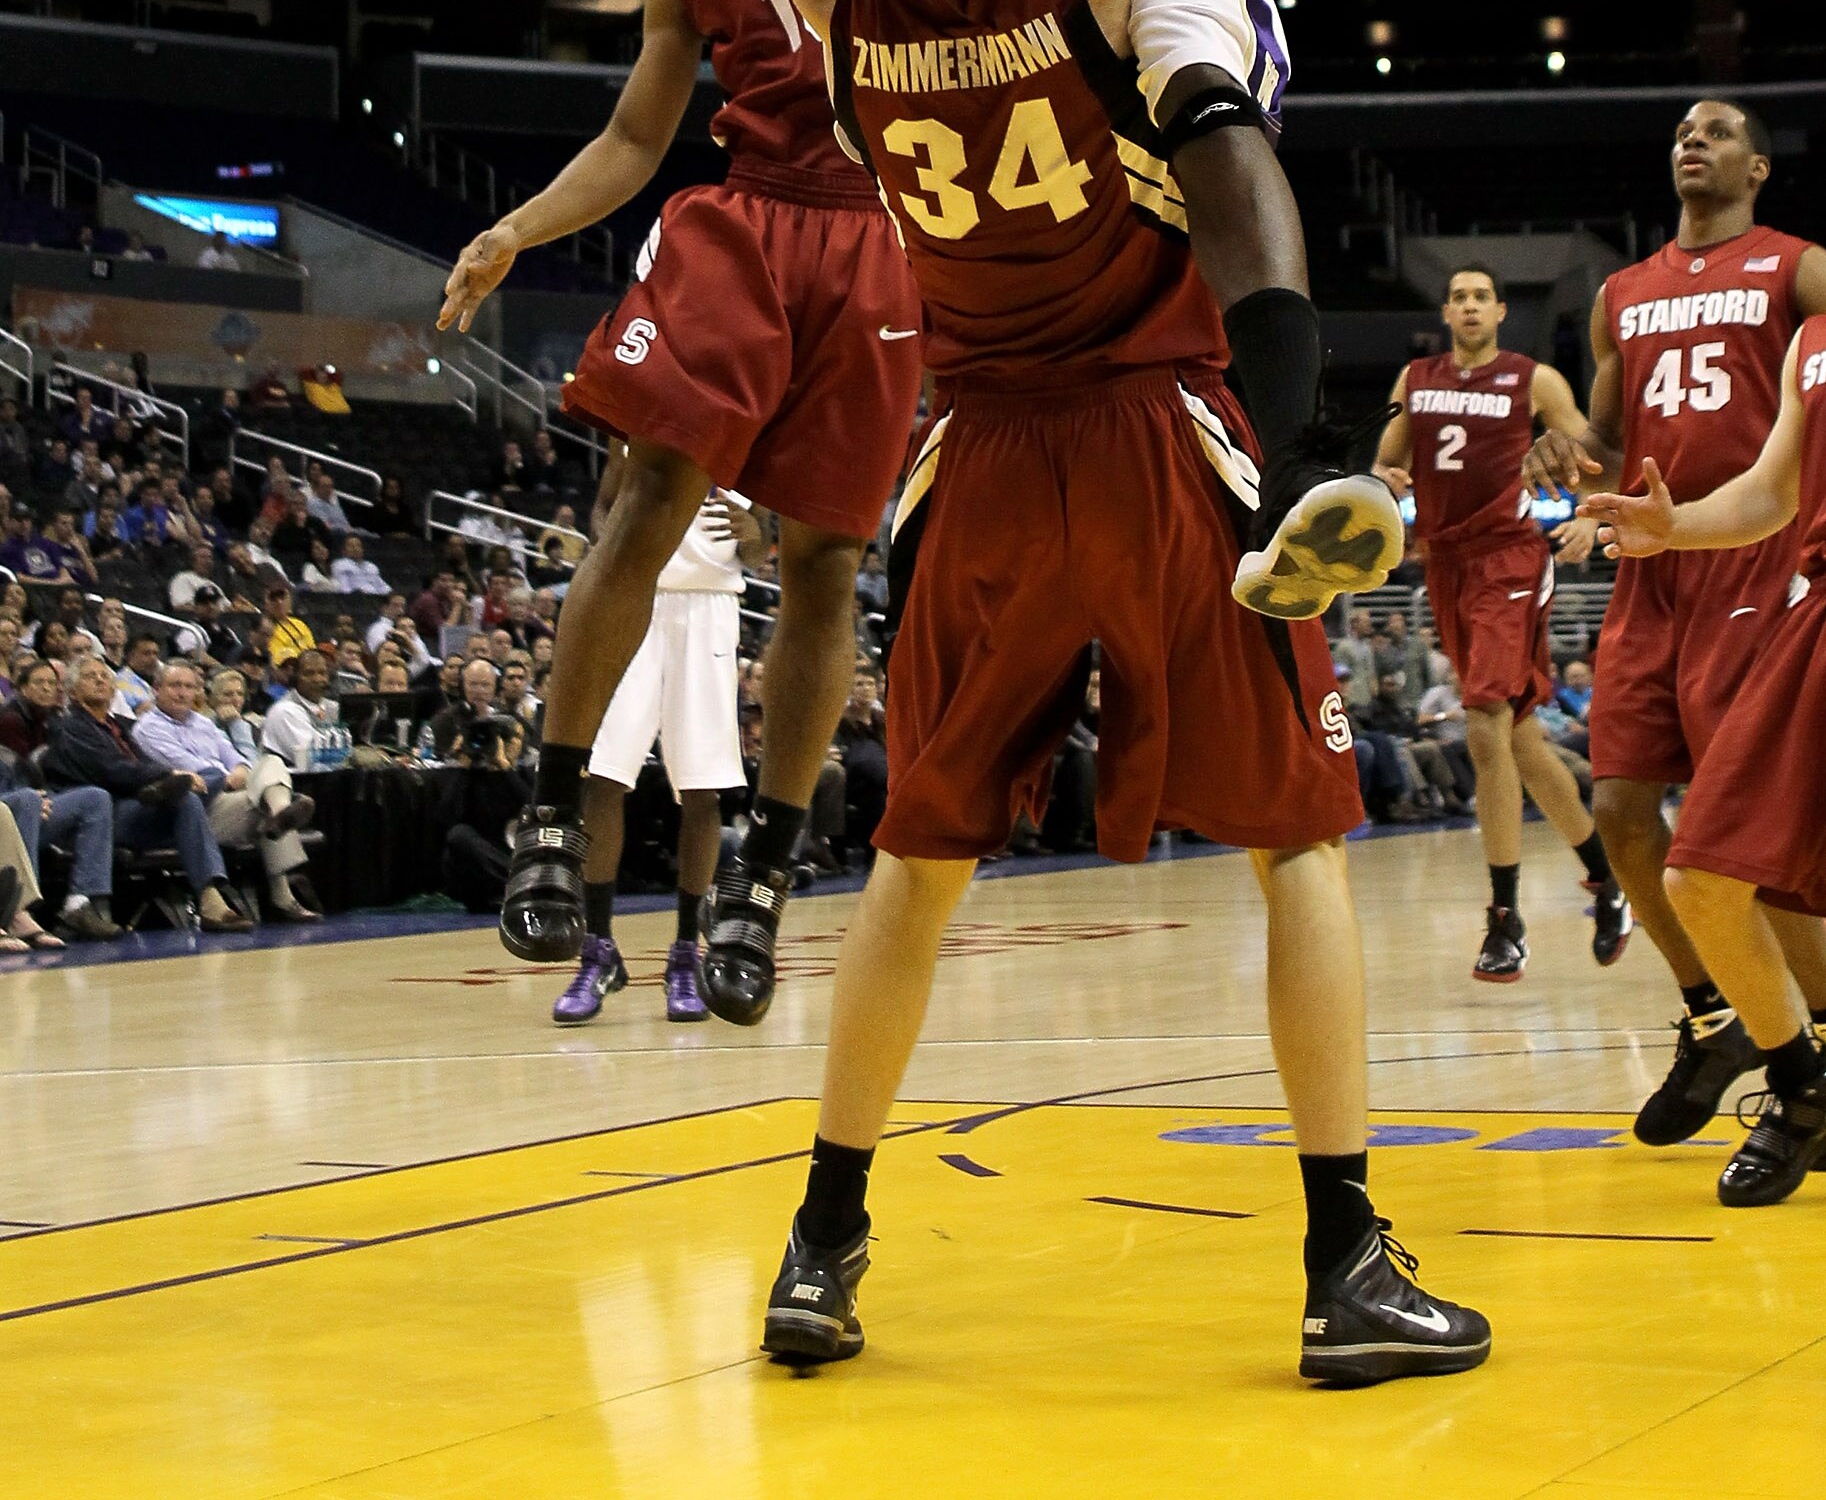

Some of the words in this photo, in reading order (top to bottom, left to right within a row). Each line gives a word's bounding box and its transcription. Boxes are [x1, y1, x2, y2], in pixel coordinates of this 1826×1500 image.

[853, 12, 1072, 93] ZIMMERMANN
[882, 97, 1094, 241] 34
[614, 316, 658, 366] S
[1619, 288, 1770, 342] STANFORD
[1410, 389, 1512, 419] STANFORD
[1643, 342, 1733, 418] 45
[1435, 424, 1468, 472] 2
[1319, 690, 1354, 755] S
